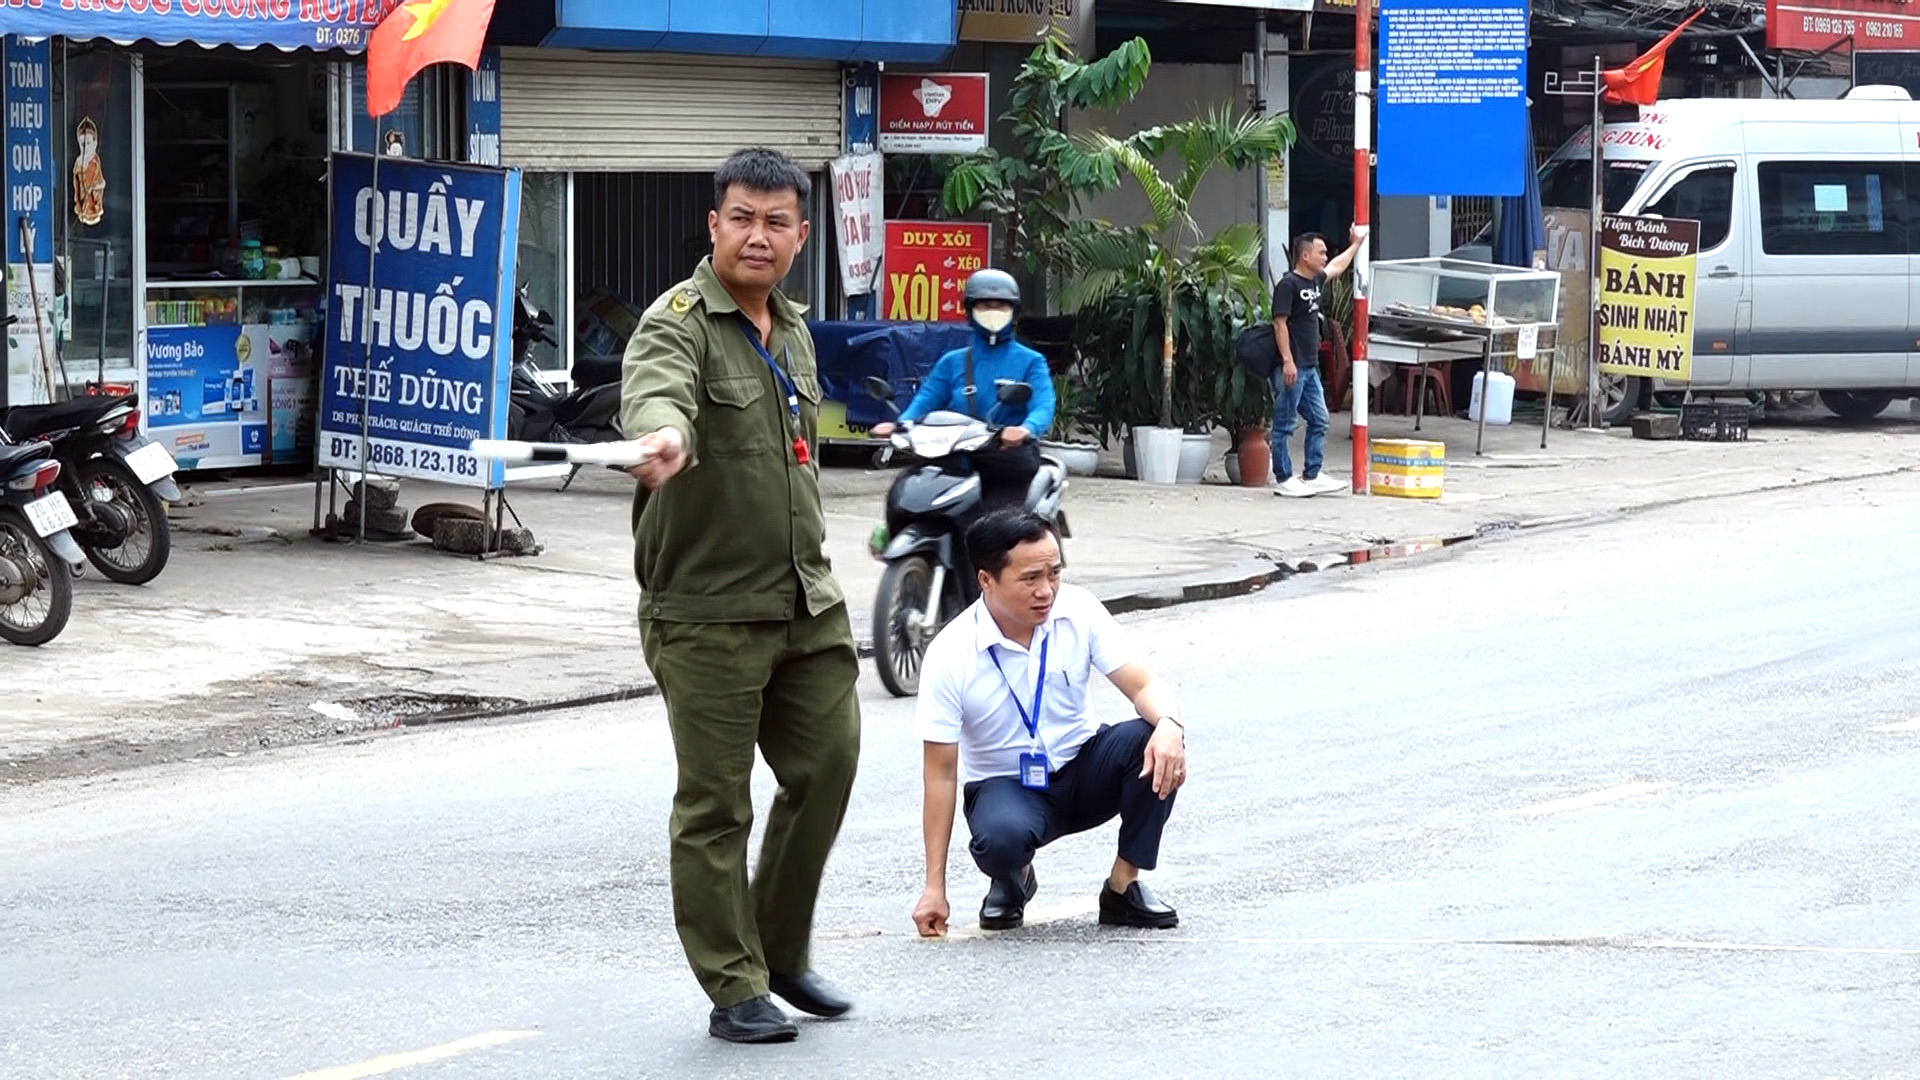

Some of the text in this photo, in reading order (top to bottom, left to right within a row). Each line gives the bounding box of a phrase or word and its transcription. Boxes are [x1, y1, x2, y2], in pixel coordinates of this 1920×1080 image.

[10, 57, 43, 88] TOÀN
[10, 97, 43, 134] HIỆU
[13, 138, 42, 173] QUẢ
[13, 182, 43, 217] HỢP
[354, 174, 485, 257] QUẦY
[903, 228, 972, 247] DUY XÔI
[1602, 216, 1668, 234] Tiệm Bánh
[1619, 233, 1689, 256] Bích Dương
[889, 263, 940, 322] XÔI
[1605, 263, 1685, 299] BÁNH
[336, 276, 492, 360] THUỐC
[1600, 303, 1688, 338] SINH NHẬT
[147, 340, 204, 361] Vương Bảo
[1600, 339, 1684, 371] BÁNH MỲ
[334, 355, 484, 415] THẾ DŨNG
[400, 418, 431, 434] QUÁCH
[331, 437, 478, 477] ĐT: 0868.123.183
